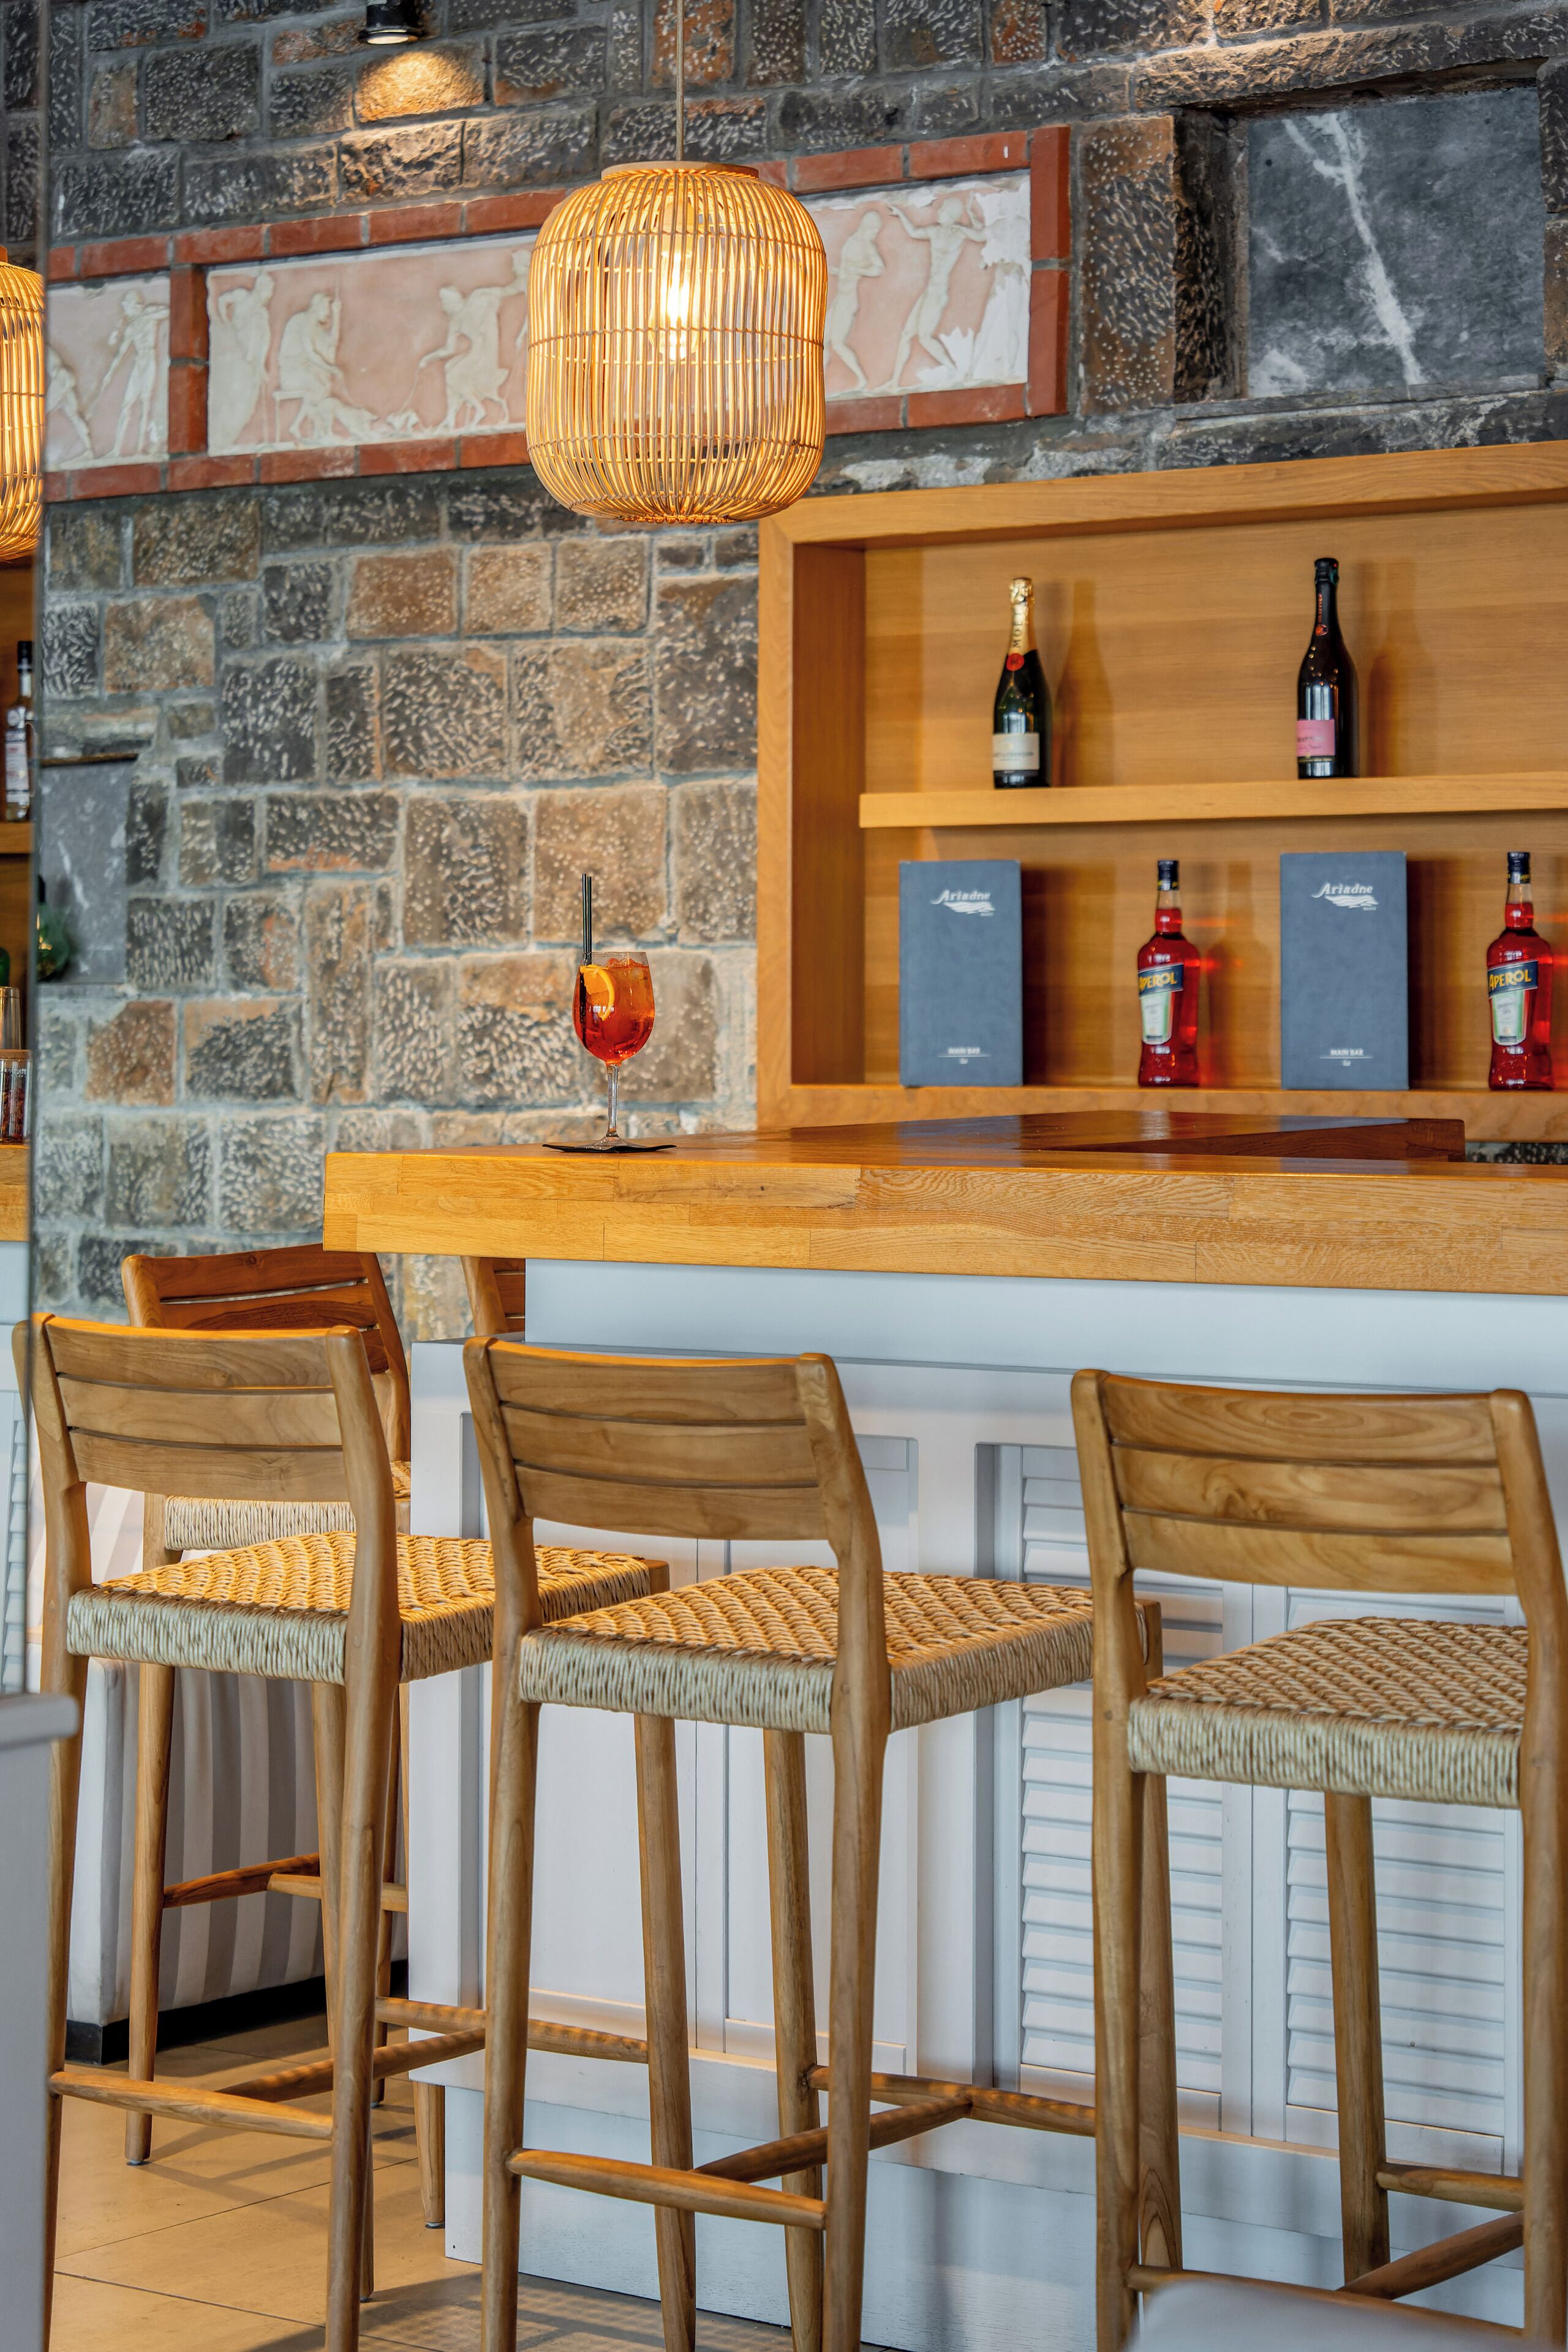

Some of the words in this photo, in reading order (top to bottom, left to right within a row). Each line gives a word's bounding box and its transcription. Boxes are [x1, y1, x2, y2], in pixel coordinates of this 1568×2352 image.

[930, 890, 990, 905] Ariadne
[1312, 883, 1373, 898] Ariadne
[1489, 969, 1532, 990] APEROL
